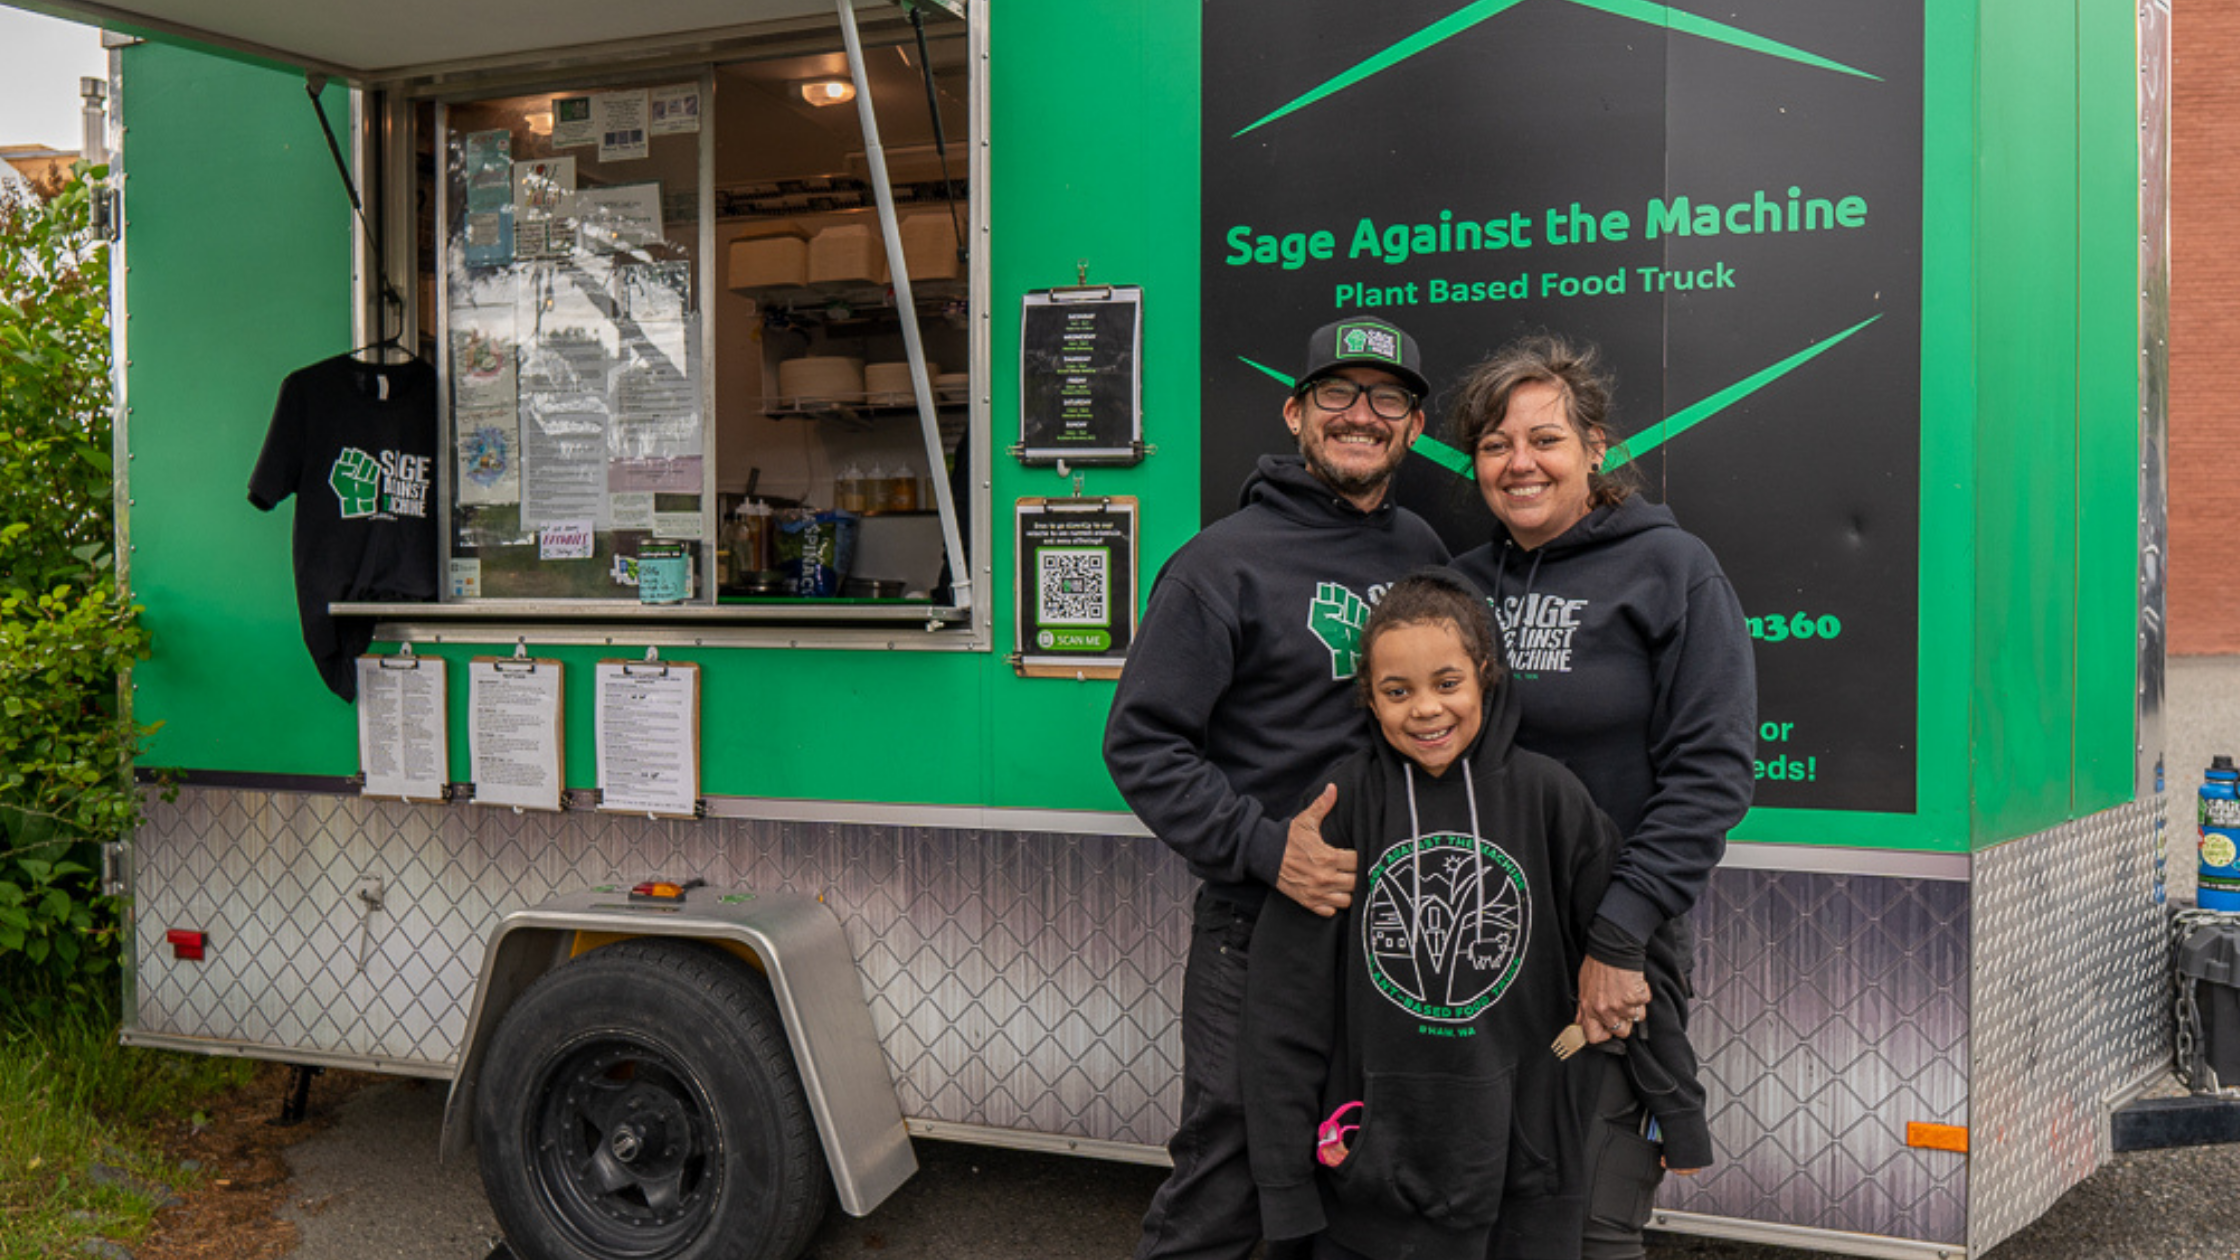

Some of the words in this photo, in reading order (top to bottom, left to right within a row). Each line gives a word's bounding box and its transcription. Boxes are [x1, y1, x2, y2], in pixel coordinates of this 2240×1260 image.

[1225, 224, 1336, 271] Sage
[1347, 208, 1533, 265] Against
[1545, 201, 1631, 246] the
[1644, 185, 1868, 241] Machine
[1334, 281, 1419, 309] Plant
[1428, 272, 1530, 304] Based
[1540, 266, 1627, 299] Food
[1635, 260, 1737, 293] Truck
[1057, 635, 1084, 646] SCAN
[1086, 635, 1101, 646] ME
[1754, 753, 1817, 782] eds!
[1455, 996, 1490, 1017] FOOD
